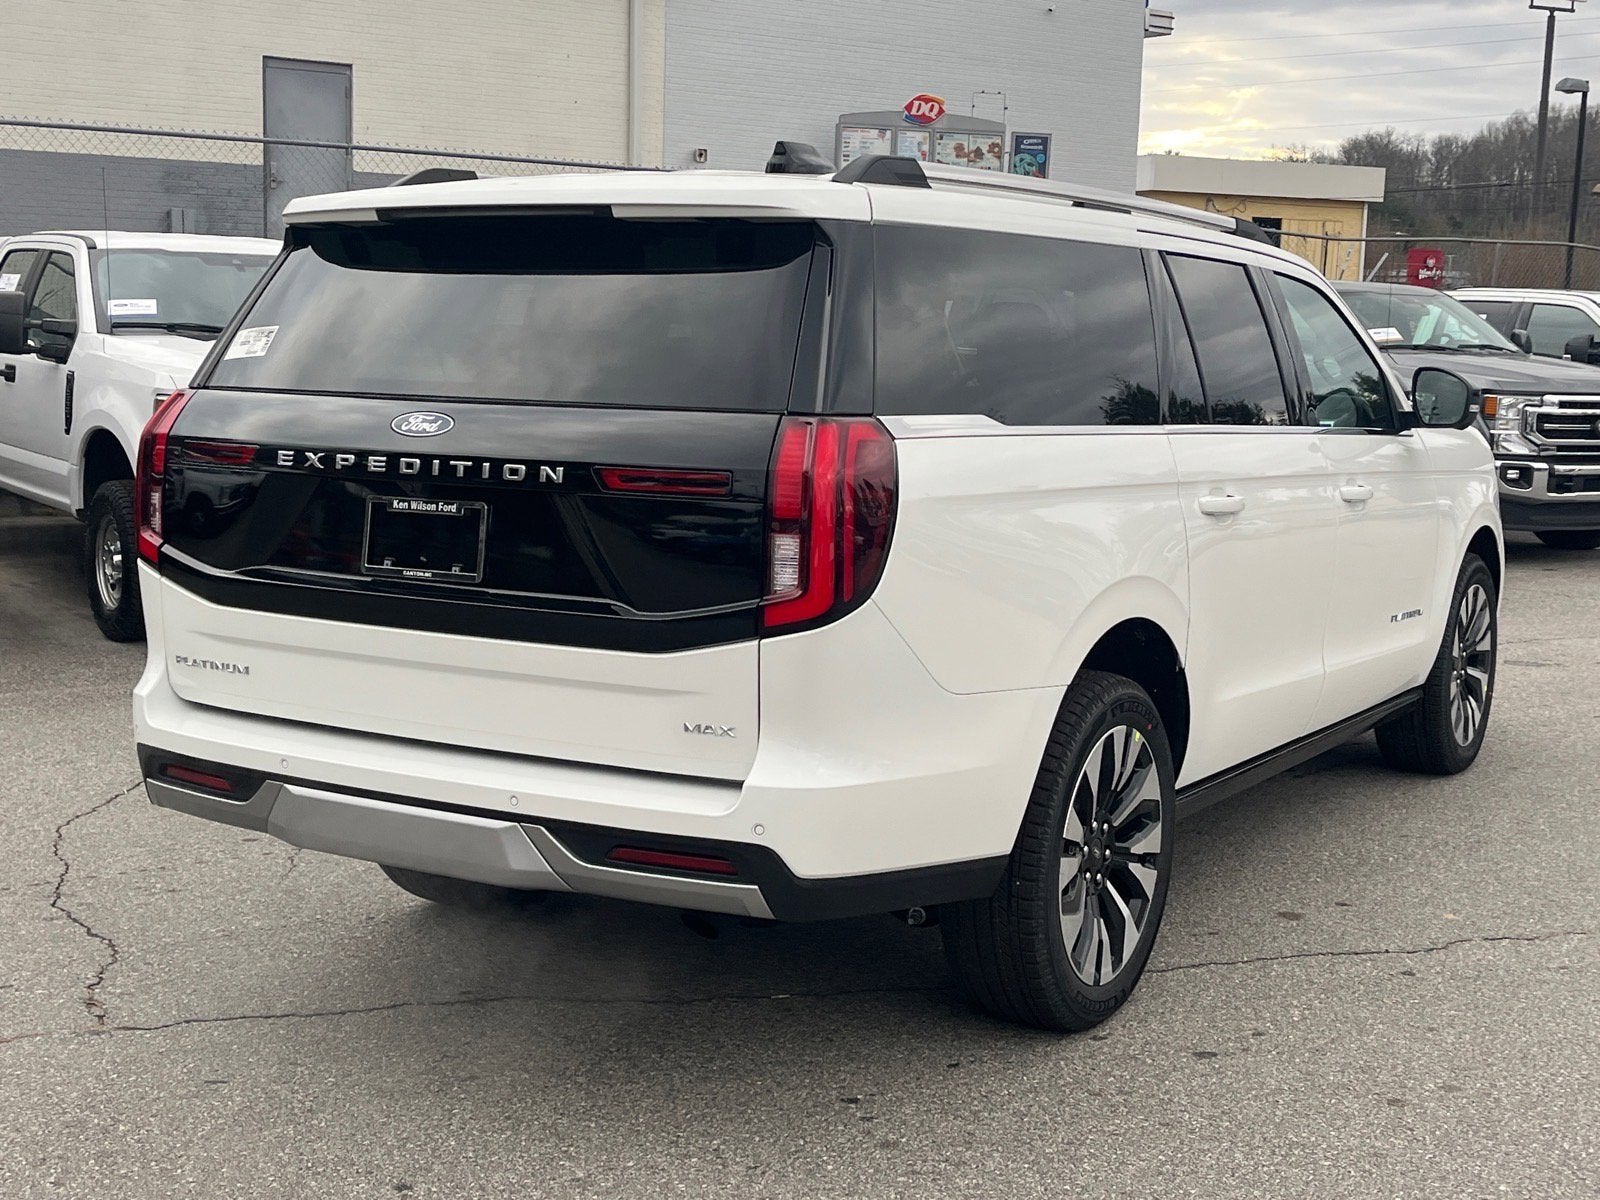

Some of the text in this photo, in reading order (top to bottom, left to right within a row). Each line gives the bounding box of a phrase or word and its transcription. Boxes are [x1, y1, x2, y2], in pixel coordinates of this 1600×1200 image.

[910, 100, 940, 119] DQ
[401, 415, 443, 432] Ford
[277, 450, 564, 484] EXPEDITION
[392, 500, 457, 513] Ken Wilson Ford
[176, 655, 250, 675] PLATINUM
[683, 721, 736, 738] MAX
